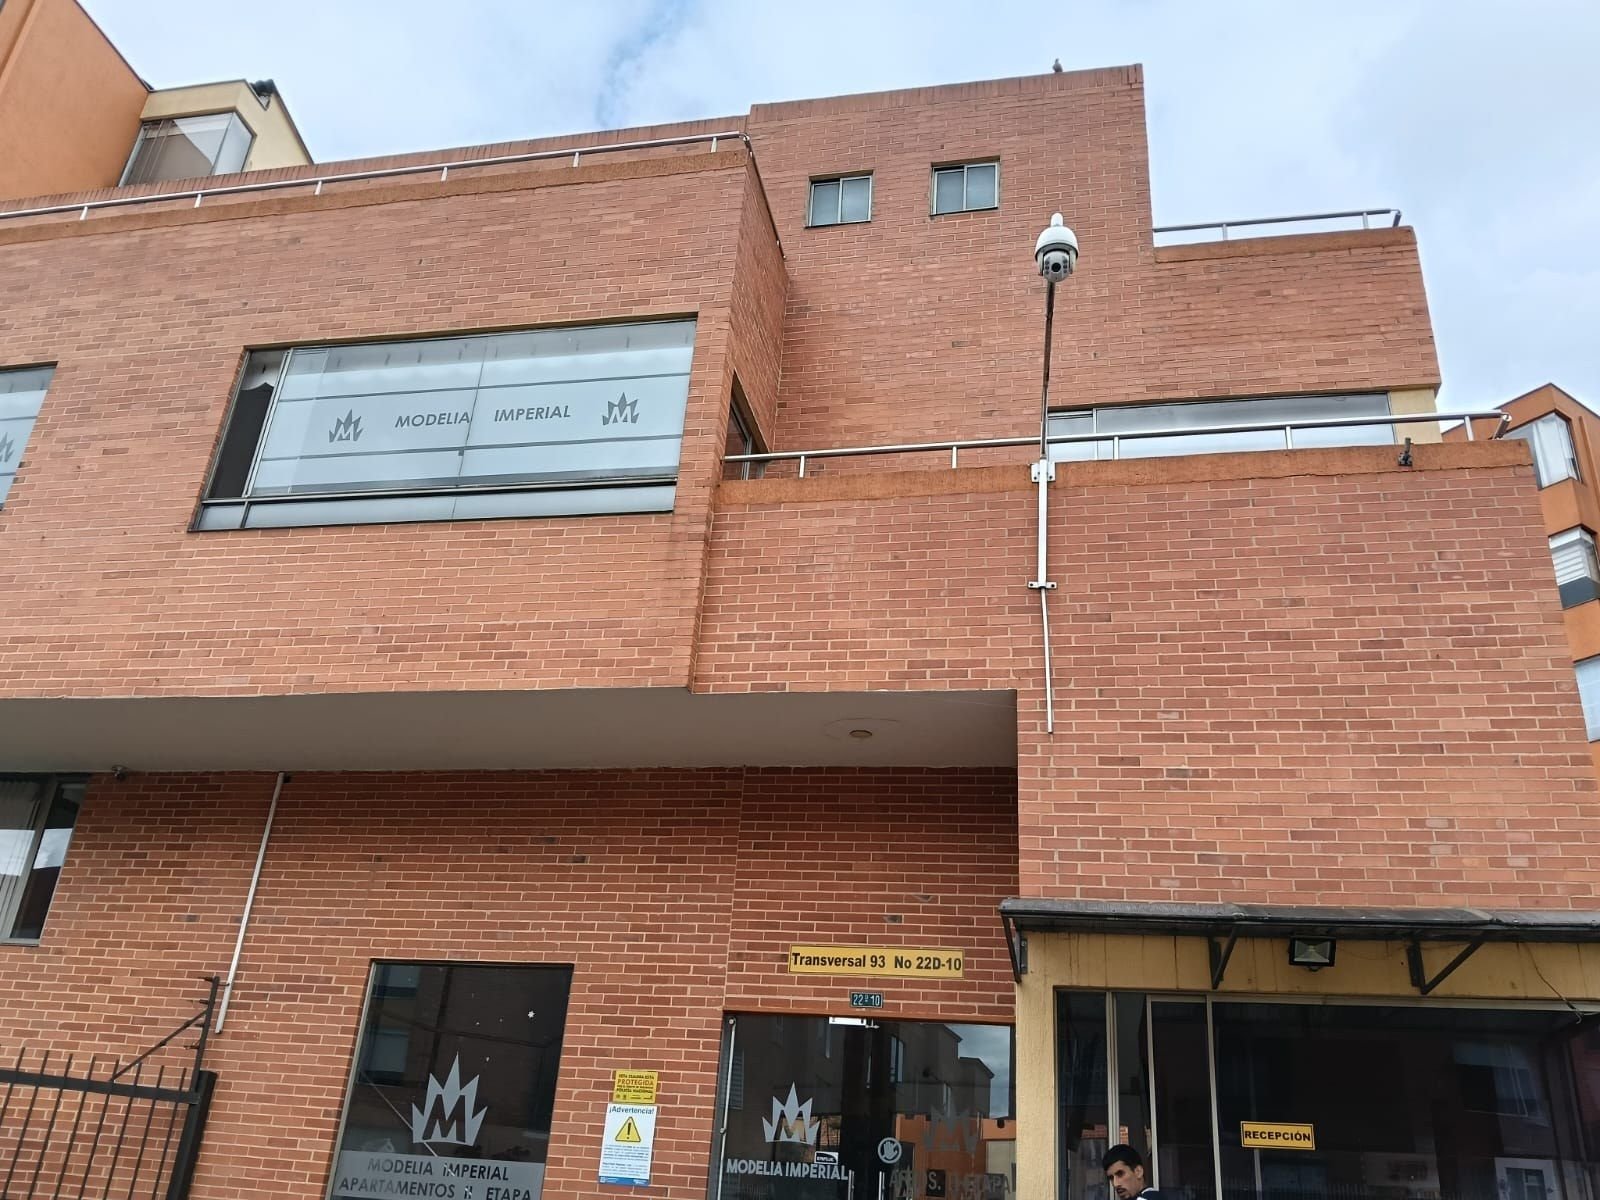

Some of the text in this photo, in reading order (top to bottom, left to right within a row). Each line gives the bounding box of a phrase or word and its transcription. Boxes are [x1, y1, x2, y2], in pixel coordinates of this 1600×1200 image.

[394, 405, 571, 428] MODELIA IMPERIAL
[792, 952, 962, 971] Transversal 93 No 22D-10
[609, 1105, 655, 1115] ¡Advertencia!
[1244, 1130, 1311, 1142] RECEPCIÓN
[367, 1158, 509, 1181] MODELIA IMPERIAL
[726, 1158, 849, 1181] MODELIA IMPERIAL
[339, 1177, 455, 1199] APARTAMENTOS
[486, 1187, 532, 1200] ETAPA
